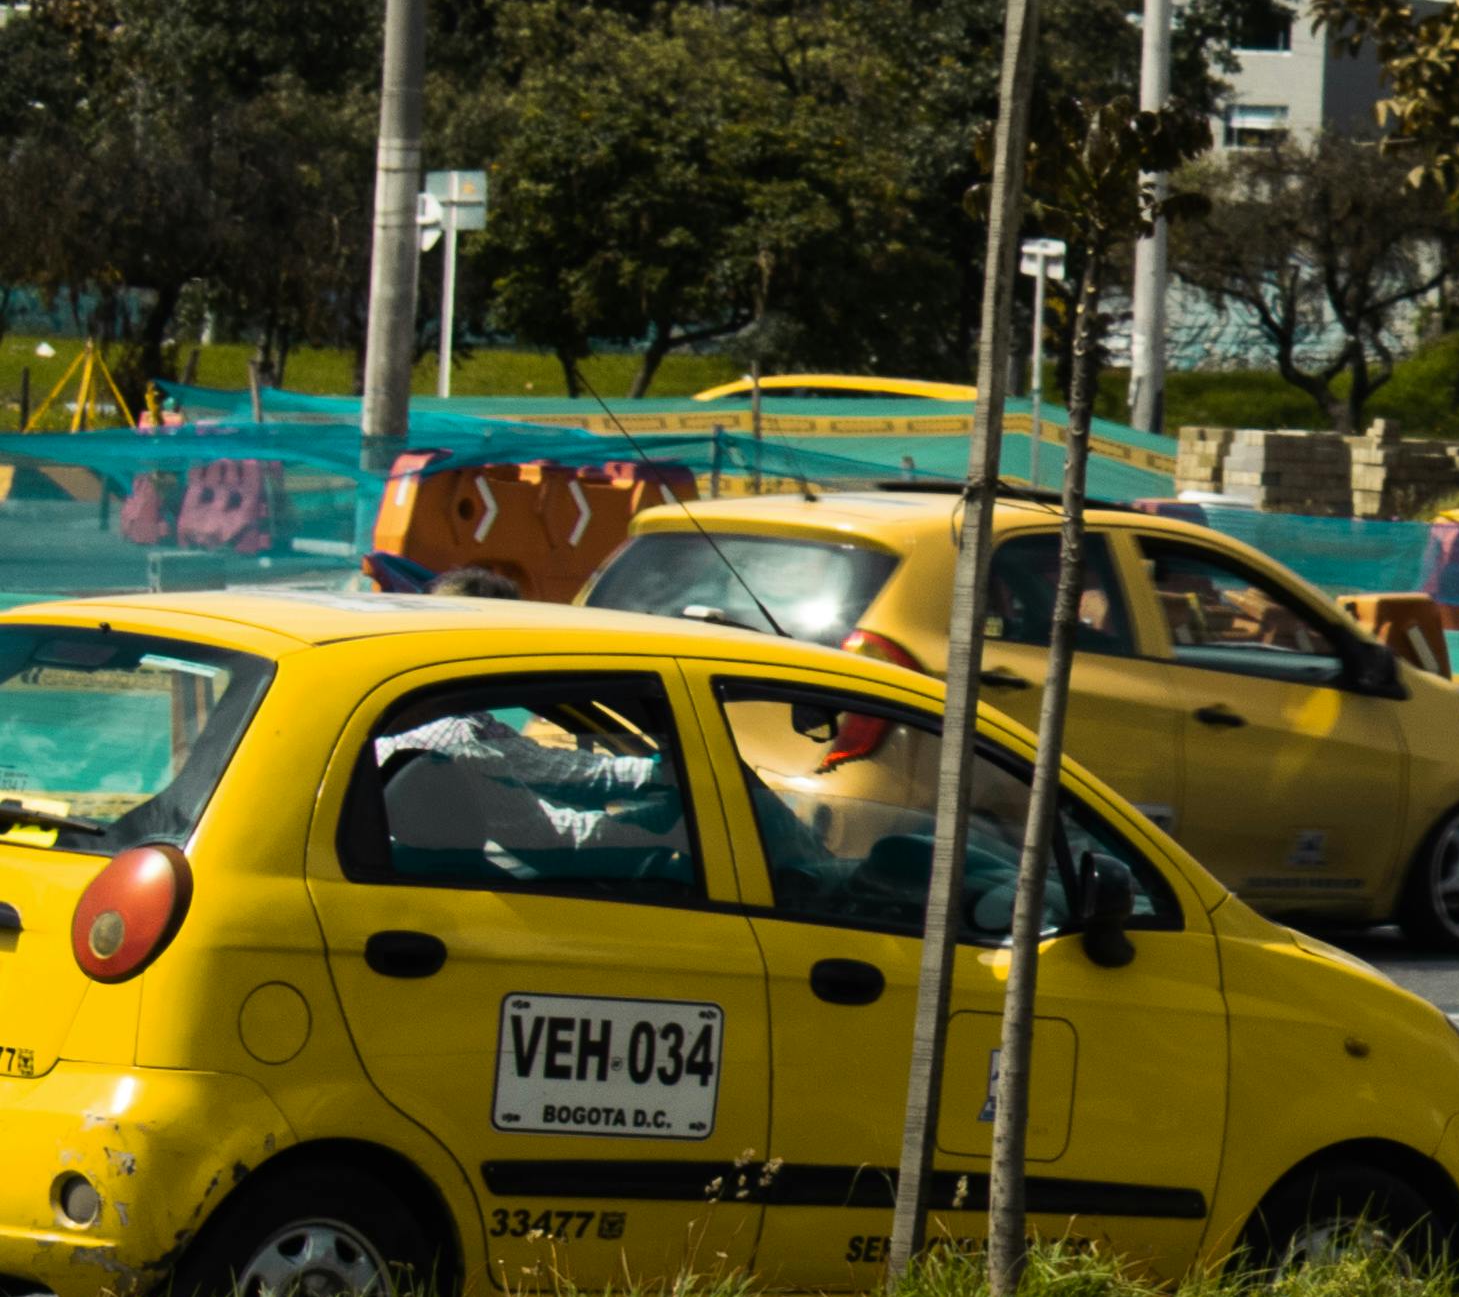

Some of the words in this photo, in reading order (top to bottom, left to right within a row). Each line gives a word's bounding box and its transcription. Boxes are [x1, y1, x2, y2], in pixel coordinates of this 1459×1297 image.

[543, 1104, 627, 1127] BOGOTA
[633, 1109, 673, 1130] D.C.
[490, 1208, 596, 1239] 33477
